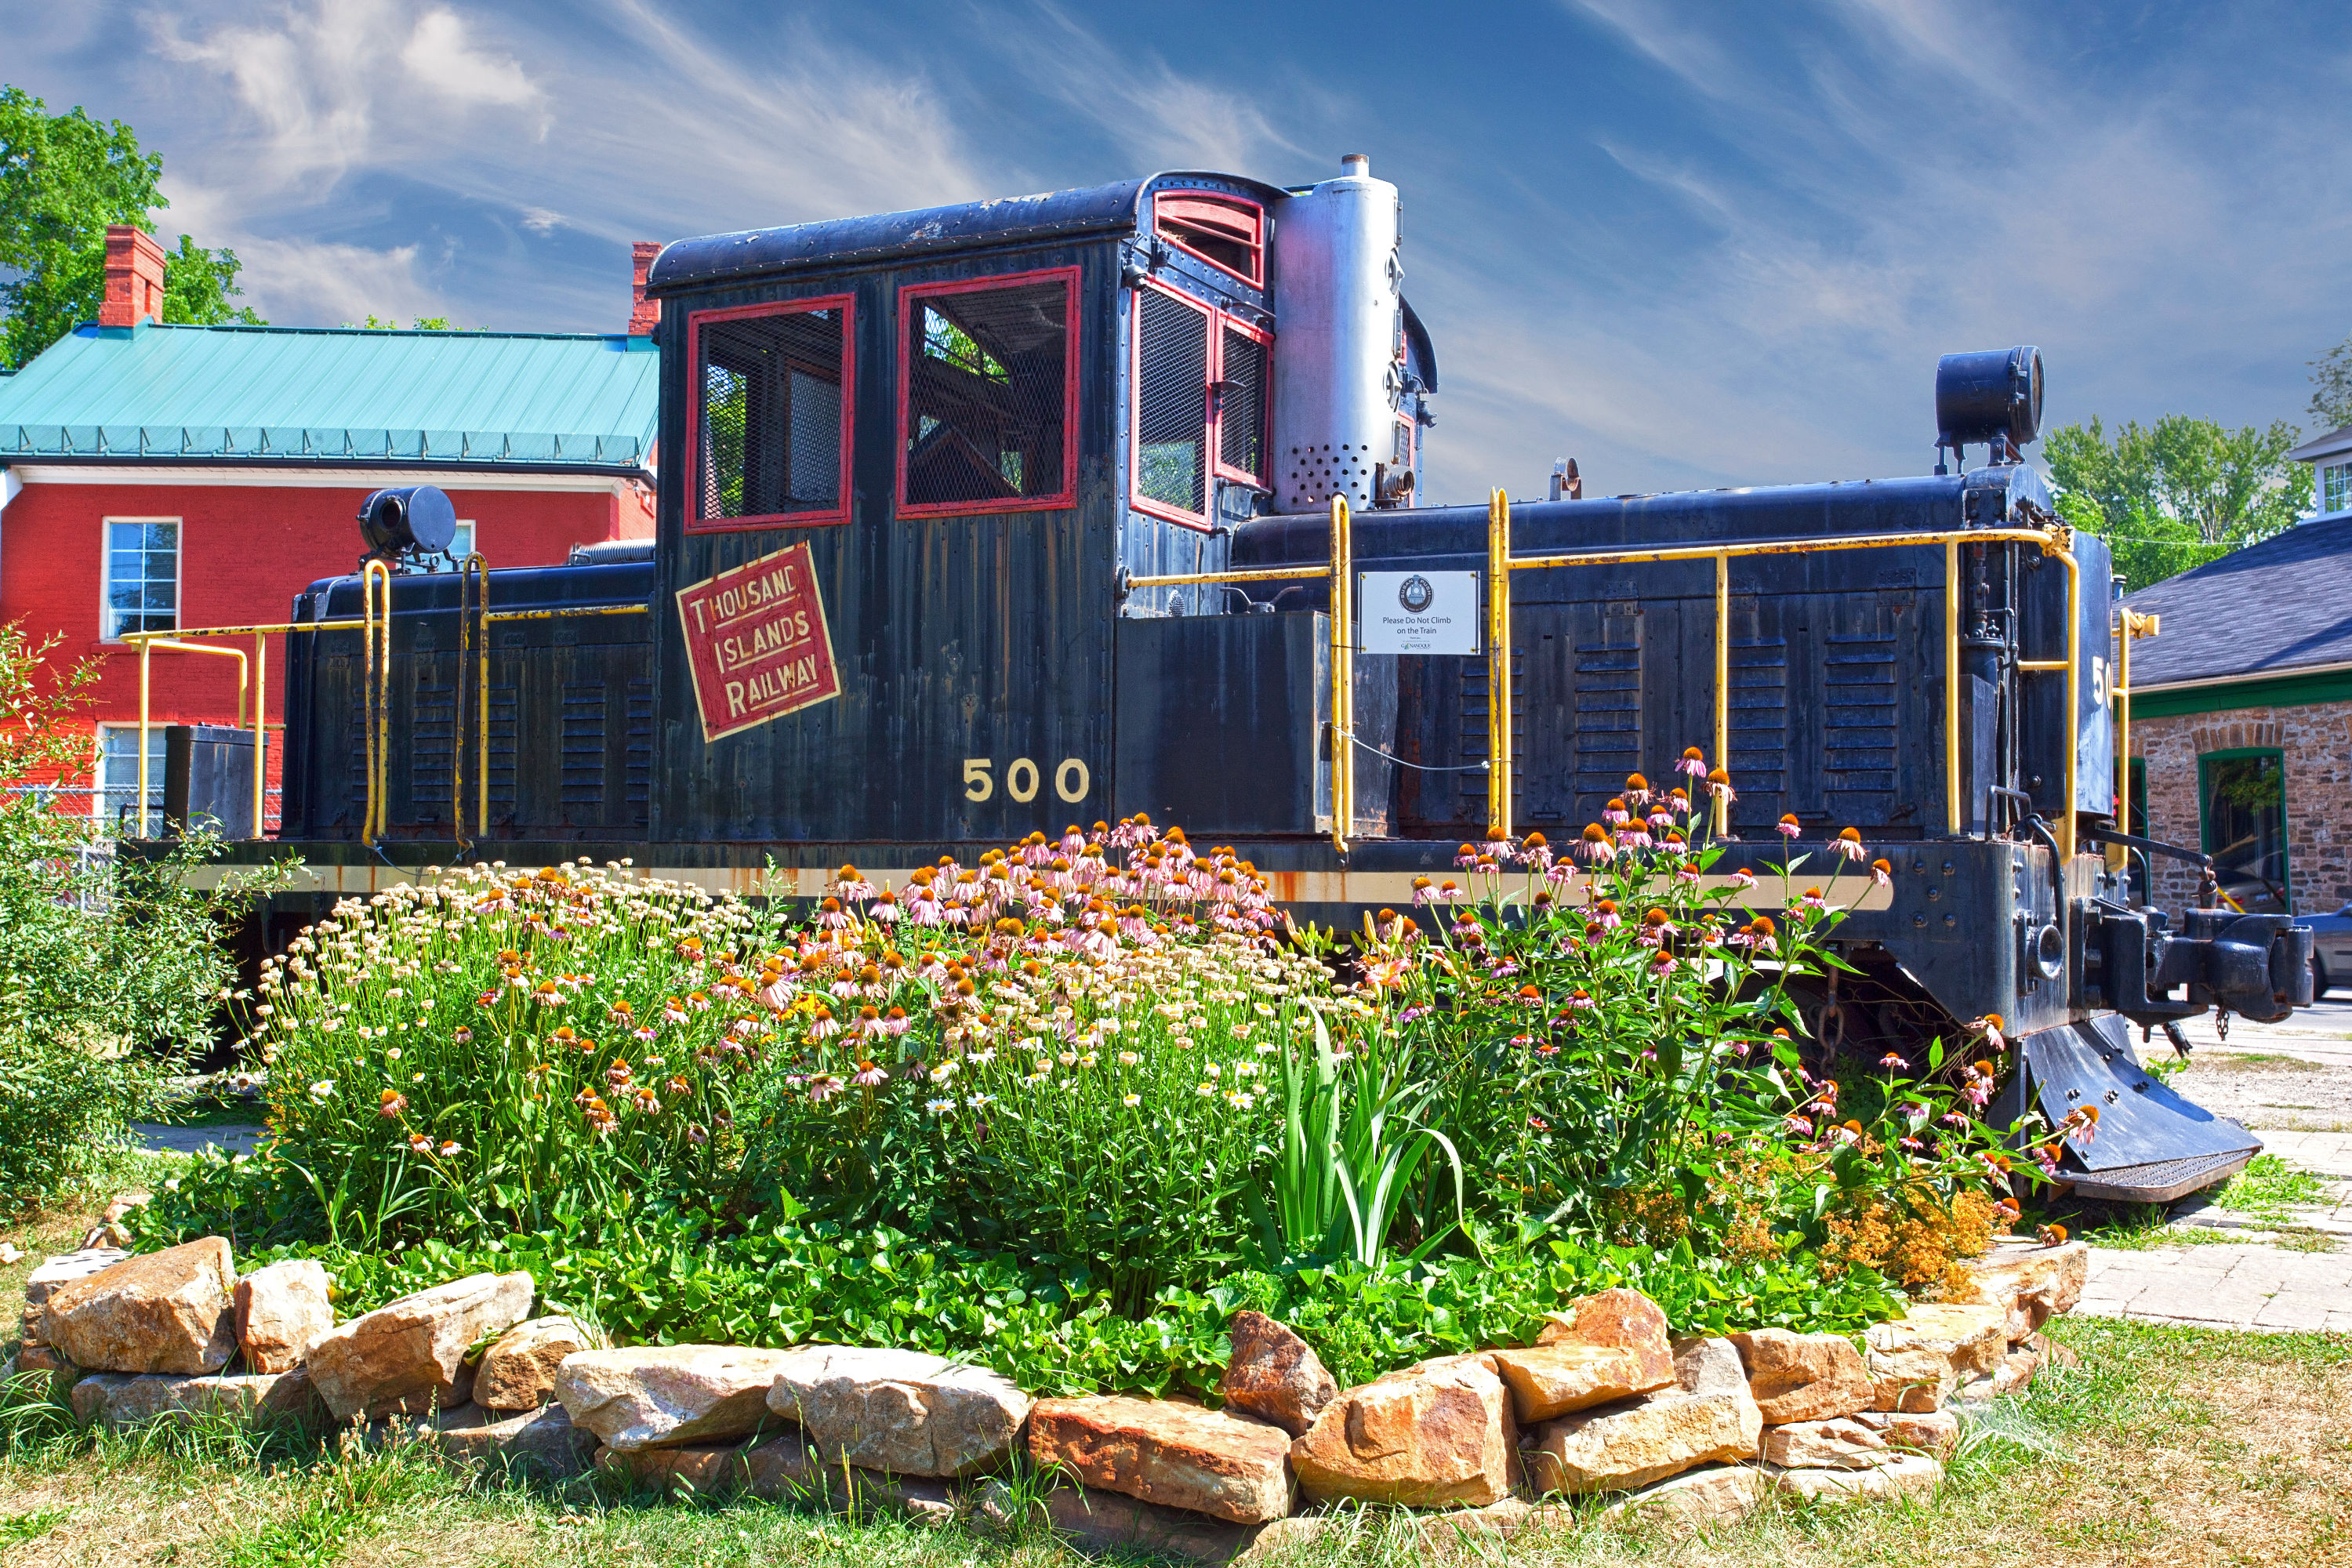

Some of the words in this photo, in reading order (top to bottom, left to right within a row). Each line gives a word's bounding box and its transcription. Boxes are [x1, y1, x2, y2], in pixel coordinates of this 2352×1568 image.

[690, 565, 800, 633] THOUSAND
[1401, 579, 1414, 598] SUSAN
[1420, 579, 1432, 595] PUSH
[714, 610, 811, 674] ISLANDS
[725, 654, 818, 718] RAILWAY
[964, 757, 1090, 804] 500
